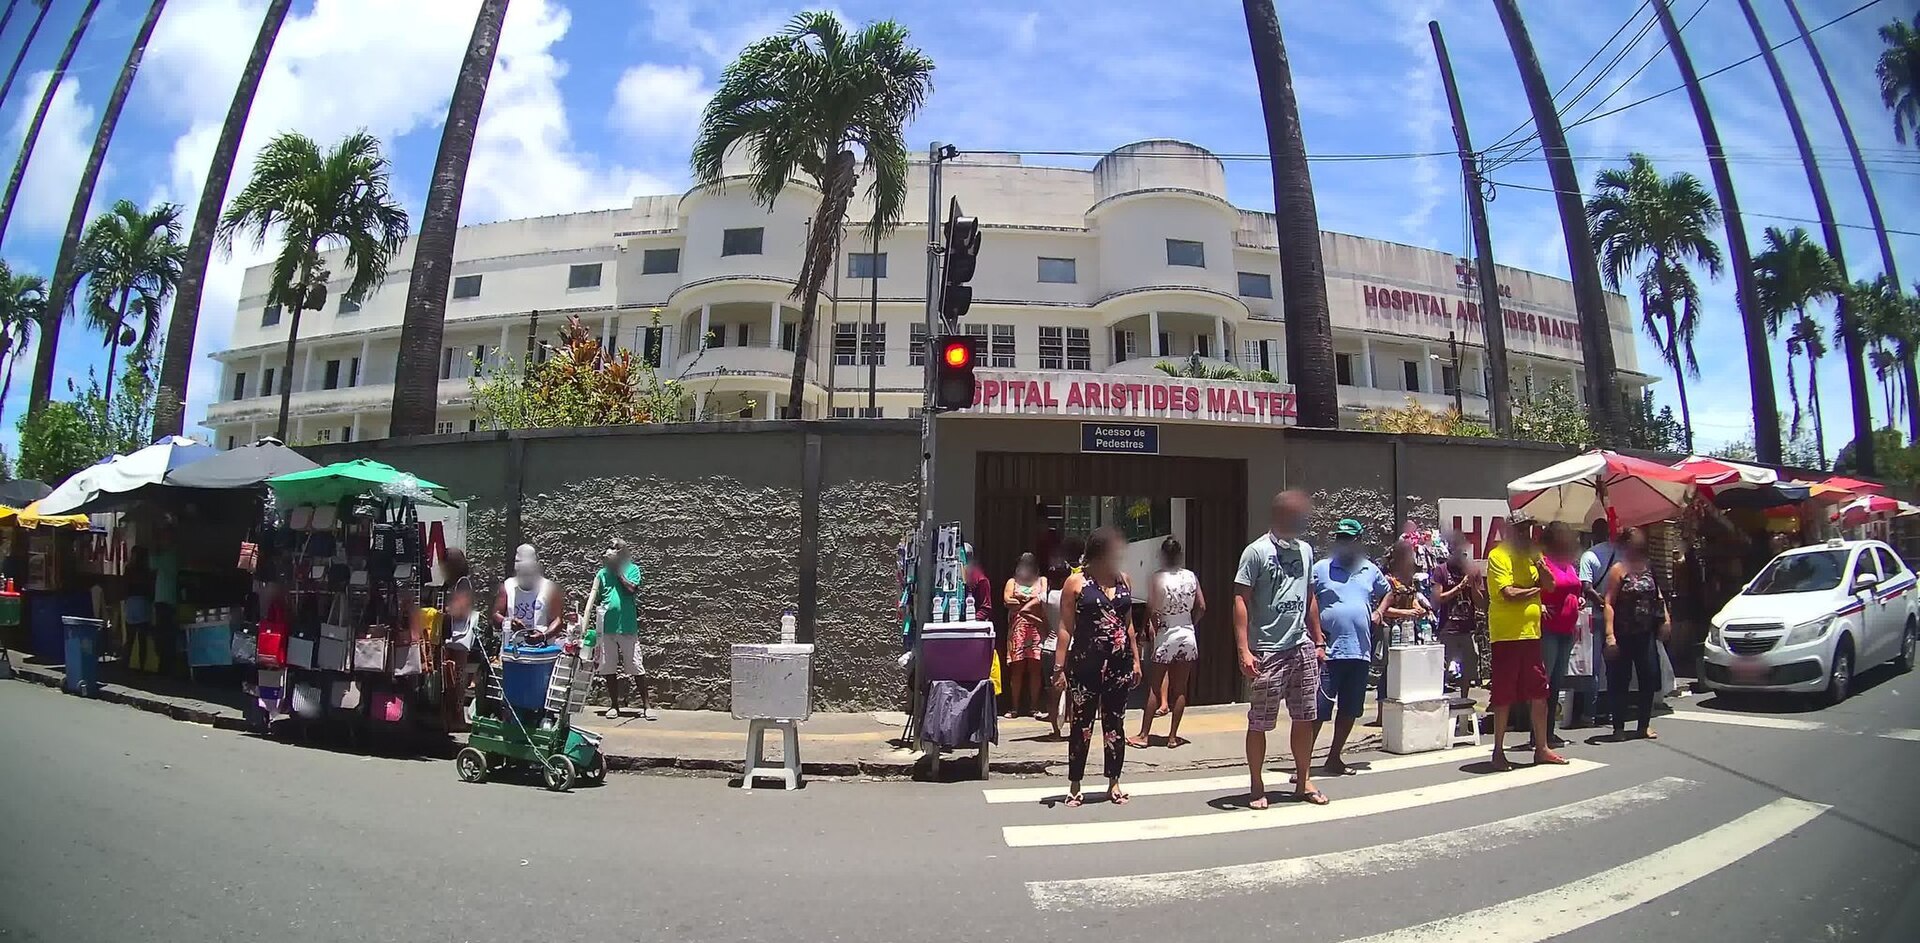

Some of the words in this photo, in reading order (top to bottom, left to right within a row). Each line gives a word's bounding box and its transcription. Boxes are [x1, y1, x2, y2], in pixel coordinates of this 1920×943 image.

[1363, 285, 1452, 319] HOSPITAL
[1456, 300, 1536, 333] ARIDES
[1538, 315, 1581, 342] MALTE
[973, 380, 1058, 407] SPITAL
[1066, 382, 1199, 412] ARISTIDES
[1207, 387, 1298, 417] MALTEZ
[1095, 426, 1131, 437] Acesso
[1133, 428, 1146, 437] de
[1096, 438, 1144, 449] Pedestres
